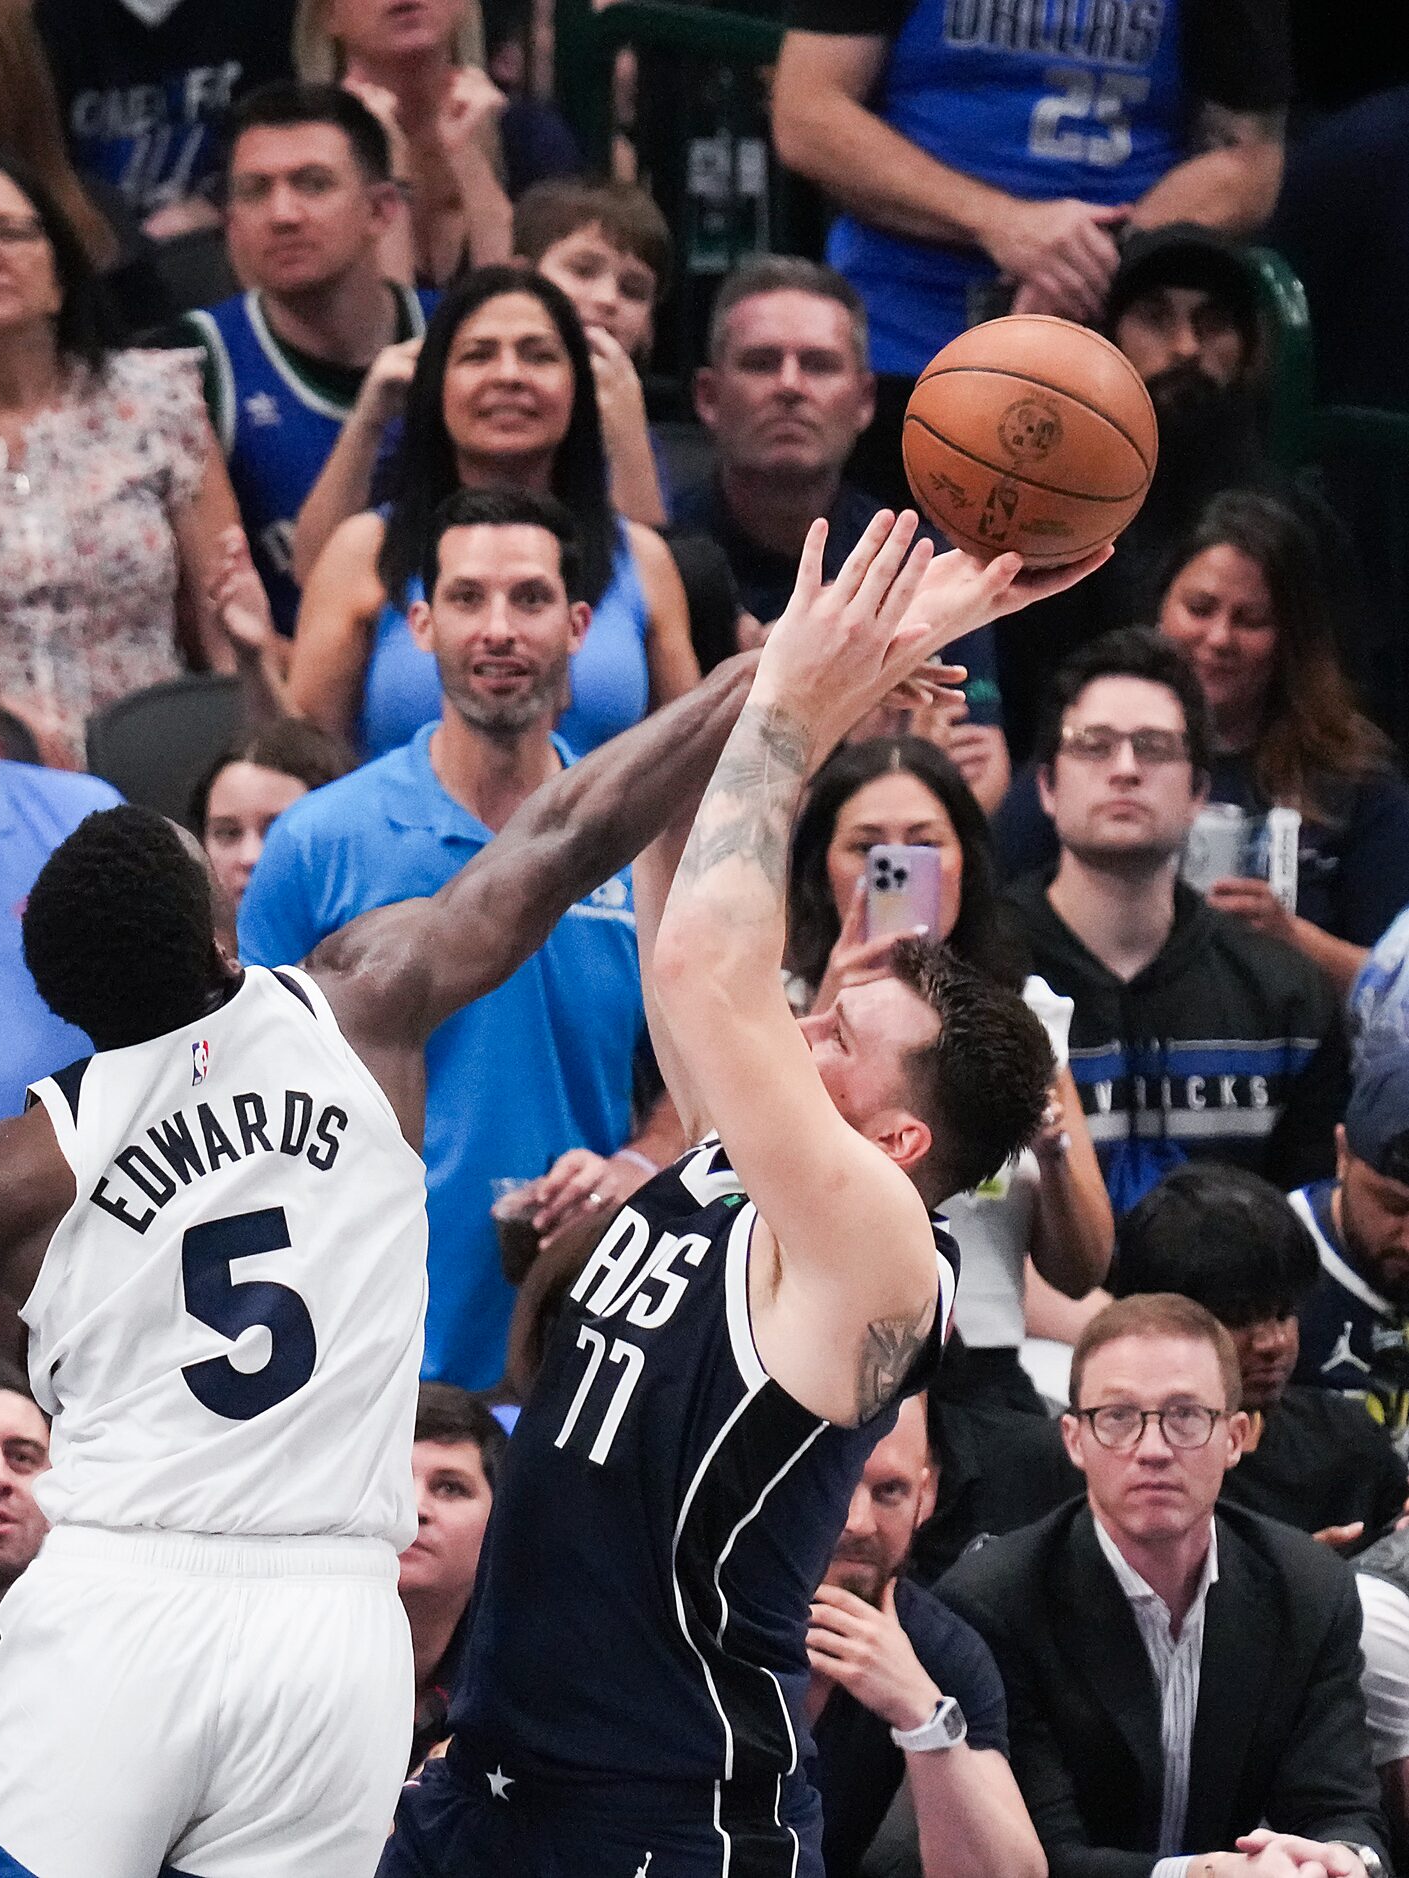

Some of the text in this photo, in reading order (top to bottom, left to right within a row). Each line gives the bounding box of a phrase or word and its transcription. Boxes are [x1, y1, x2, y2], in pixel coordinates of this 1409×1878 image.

[90, 1090, 348, 1235] EDWARDS
[180, 1206, 318, 1421] 5
[554, 1324, 646, 1466] 77
